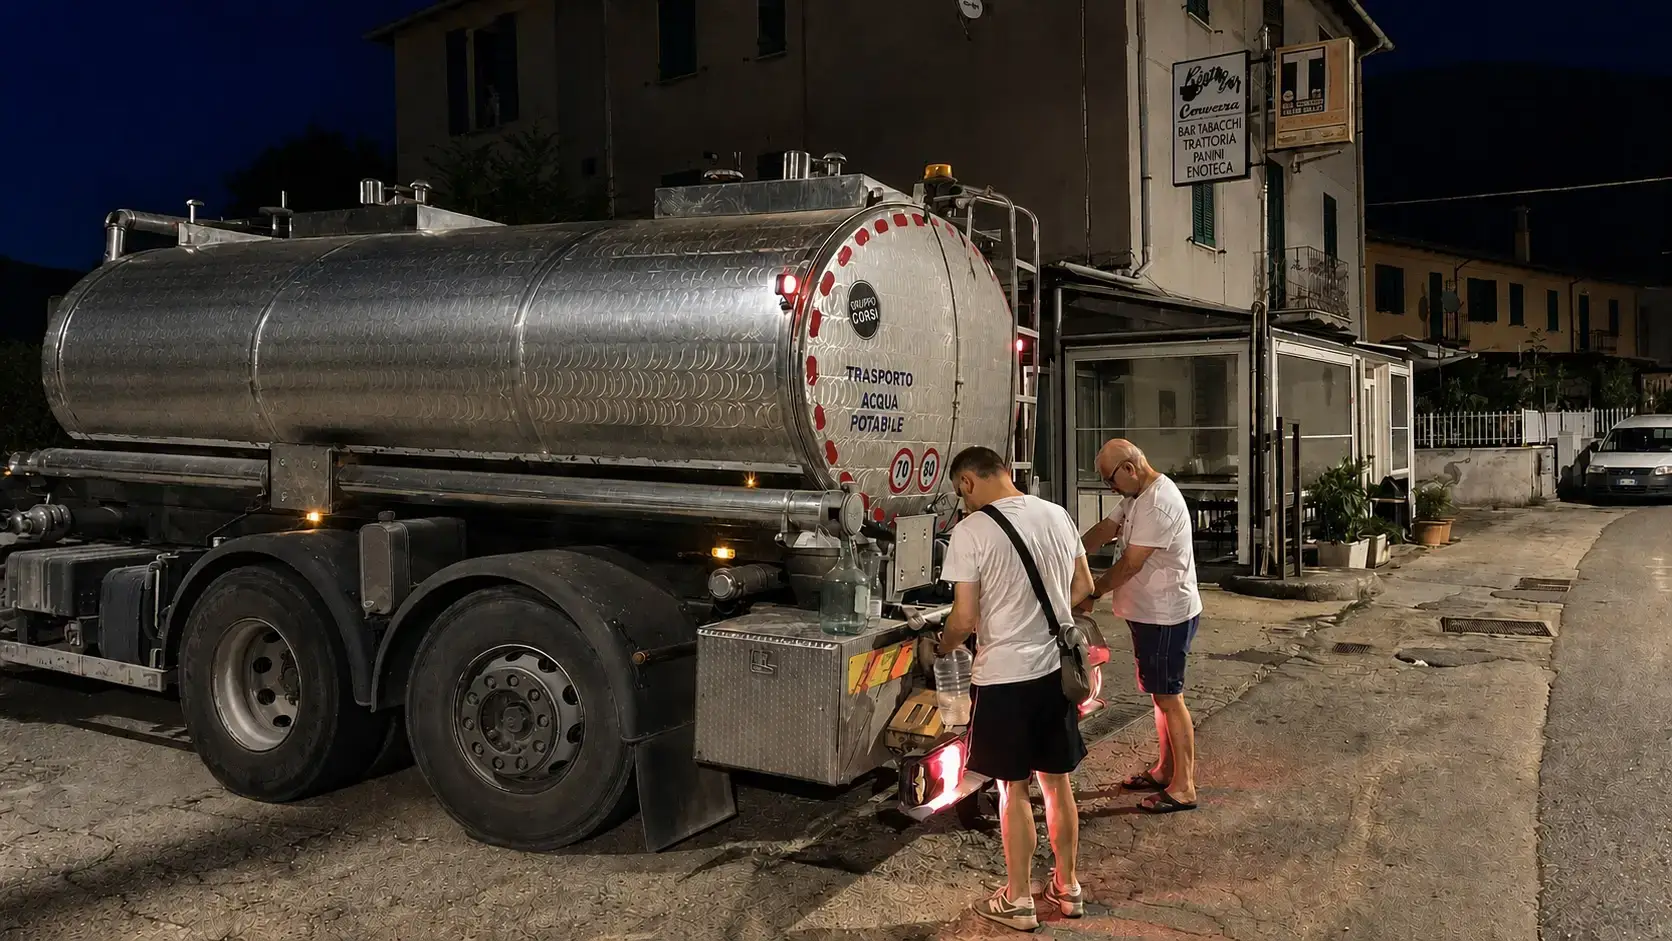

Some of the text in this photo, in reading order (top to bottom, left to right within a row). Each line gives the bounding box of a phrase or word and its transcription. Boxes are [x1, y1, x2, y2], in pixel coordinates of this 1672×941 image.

[1178, 117, 1242, 137] BAR TABACCHI
[1183, 132, 1237, 150] TRATTORIA
[1193, 148, 1224, 163] PANINI
[1187, 161, 1234, 178] ENOTECA
[850, 296, 876, 311] GRUPPO
[852, 307, 879, 325] CORSI
[846, 365, 913, 387] TRASPORTO
[861, 392, 898, 410] ACQUA
[850, 415, 904, 433] POTABILE
[895, 460, 909, 479] 70
[923, 460, 935, 477] 80
